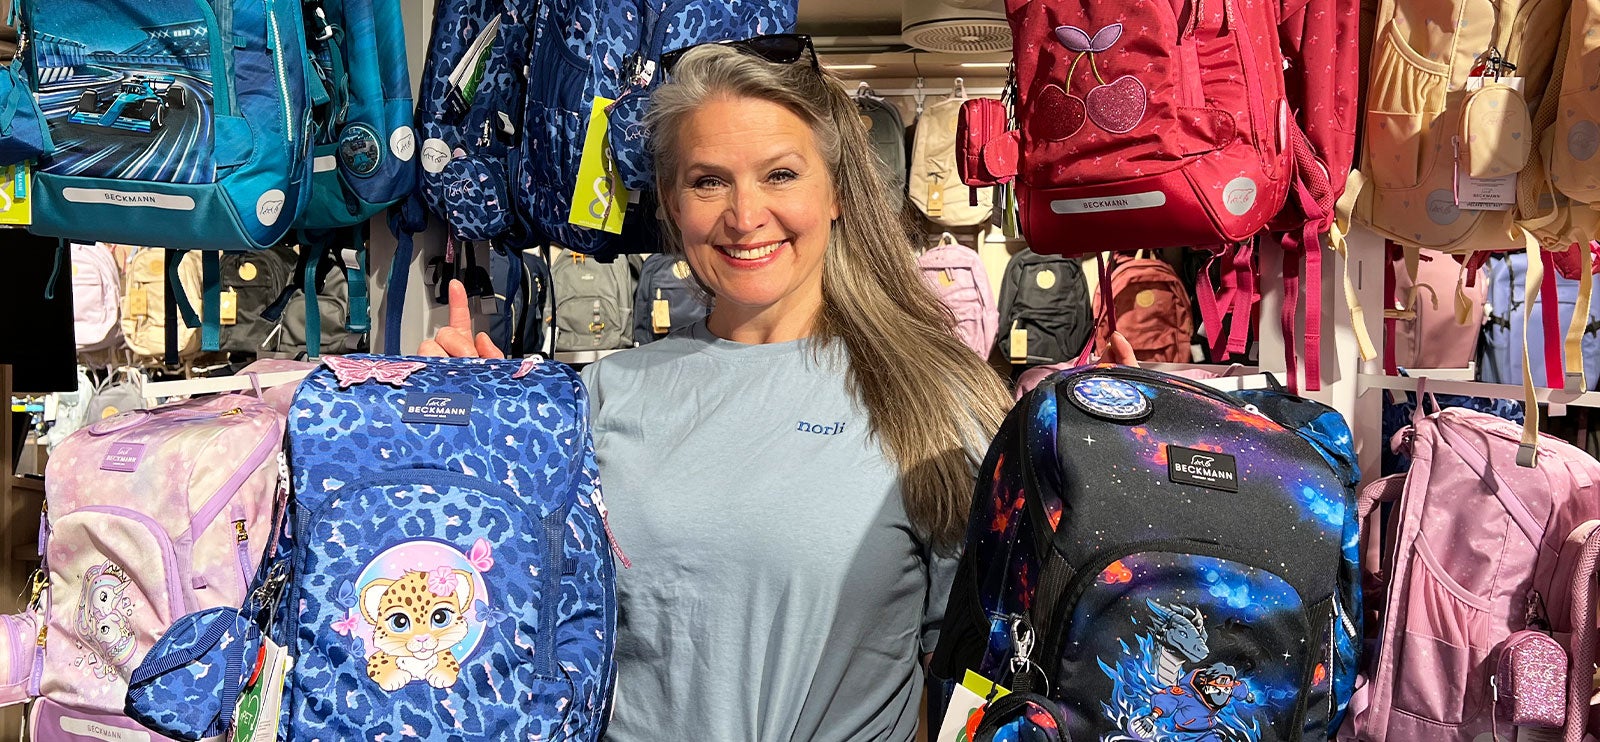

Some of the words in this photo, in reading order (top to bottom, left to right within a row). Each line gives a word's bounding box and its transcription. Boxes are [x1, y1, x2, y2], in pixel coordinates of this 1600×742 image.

[104, 193, 156, 203] BECKMANN
[1083, 199, 1129, 209] BECKMANN
[408, 406, 466, 415] BECKMANN
[797, 421, 846, 435] norli
[1174, 463, 1233, 480] BECKMANN
[87, 724, 122, 739] BECKMANN
